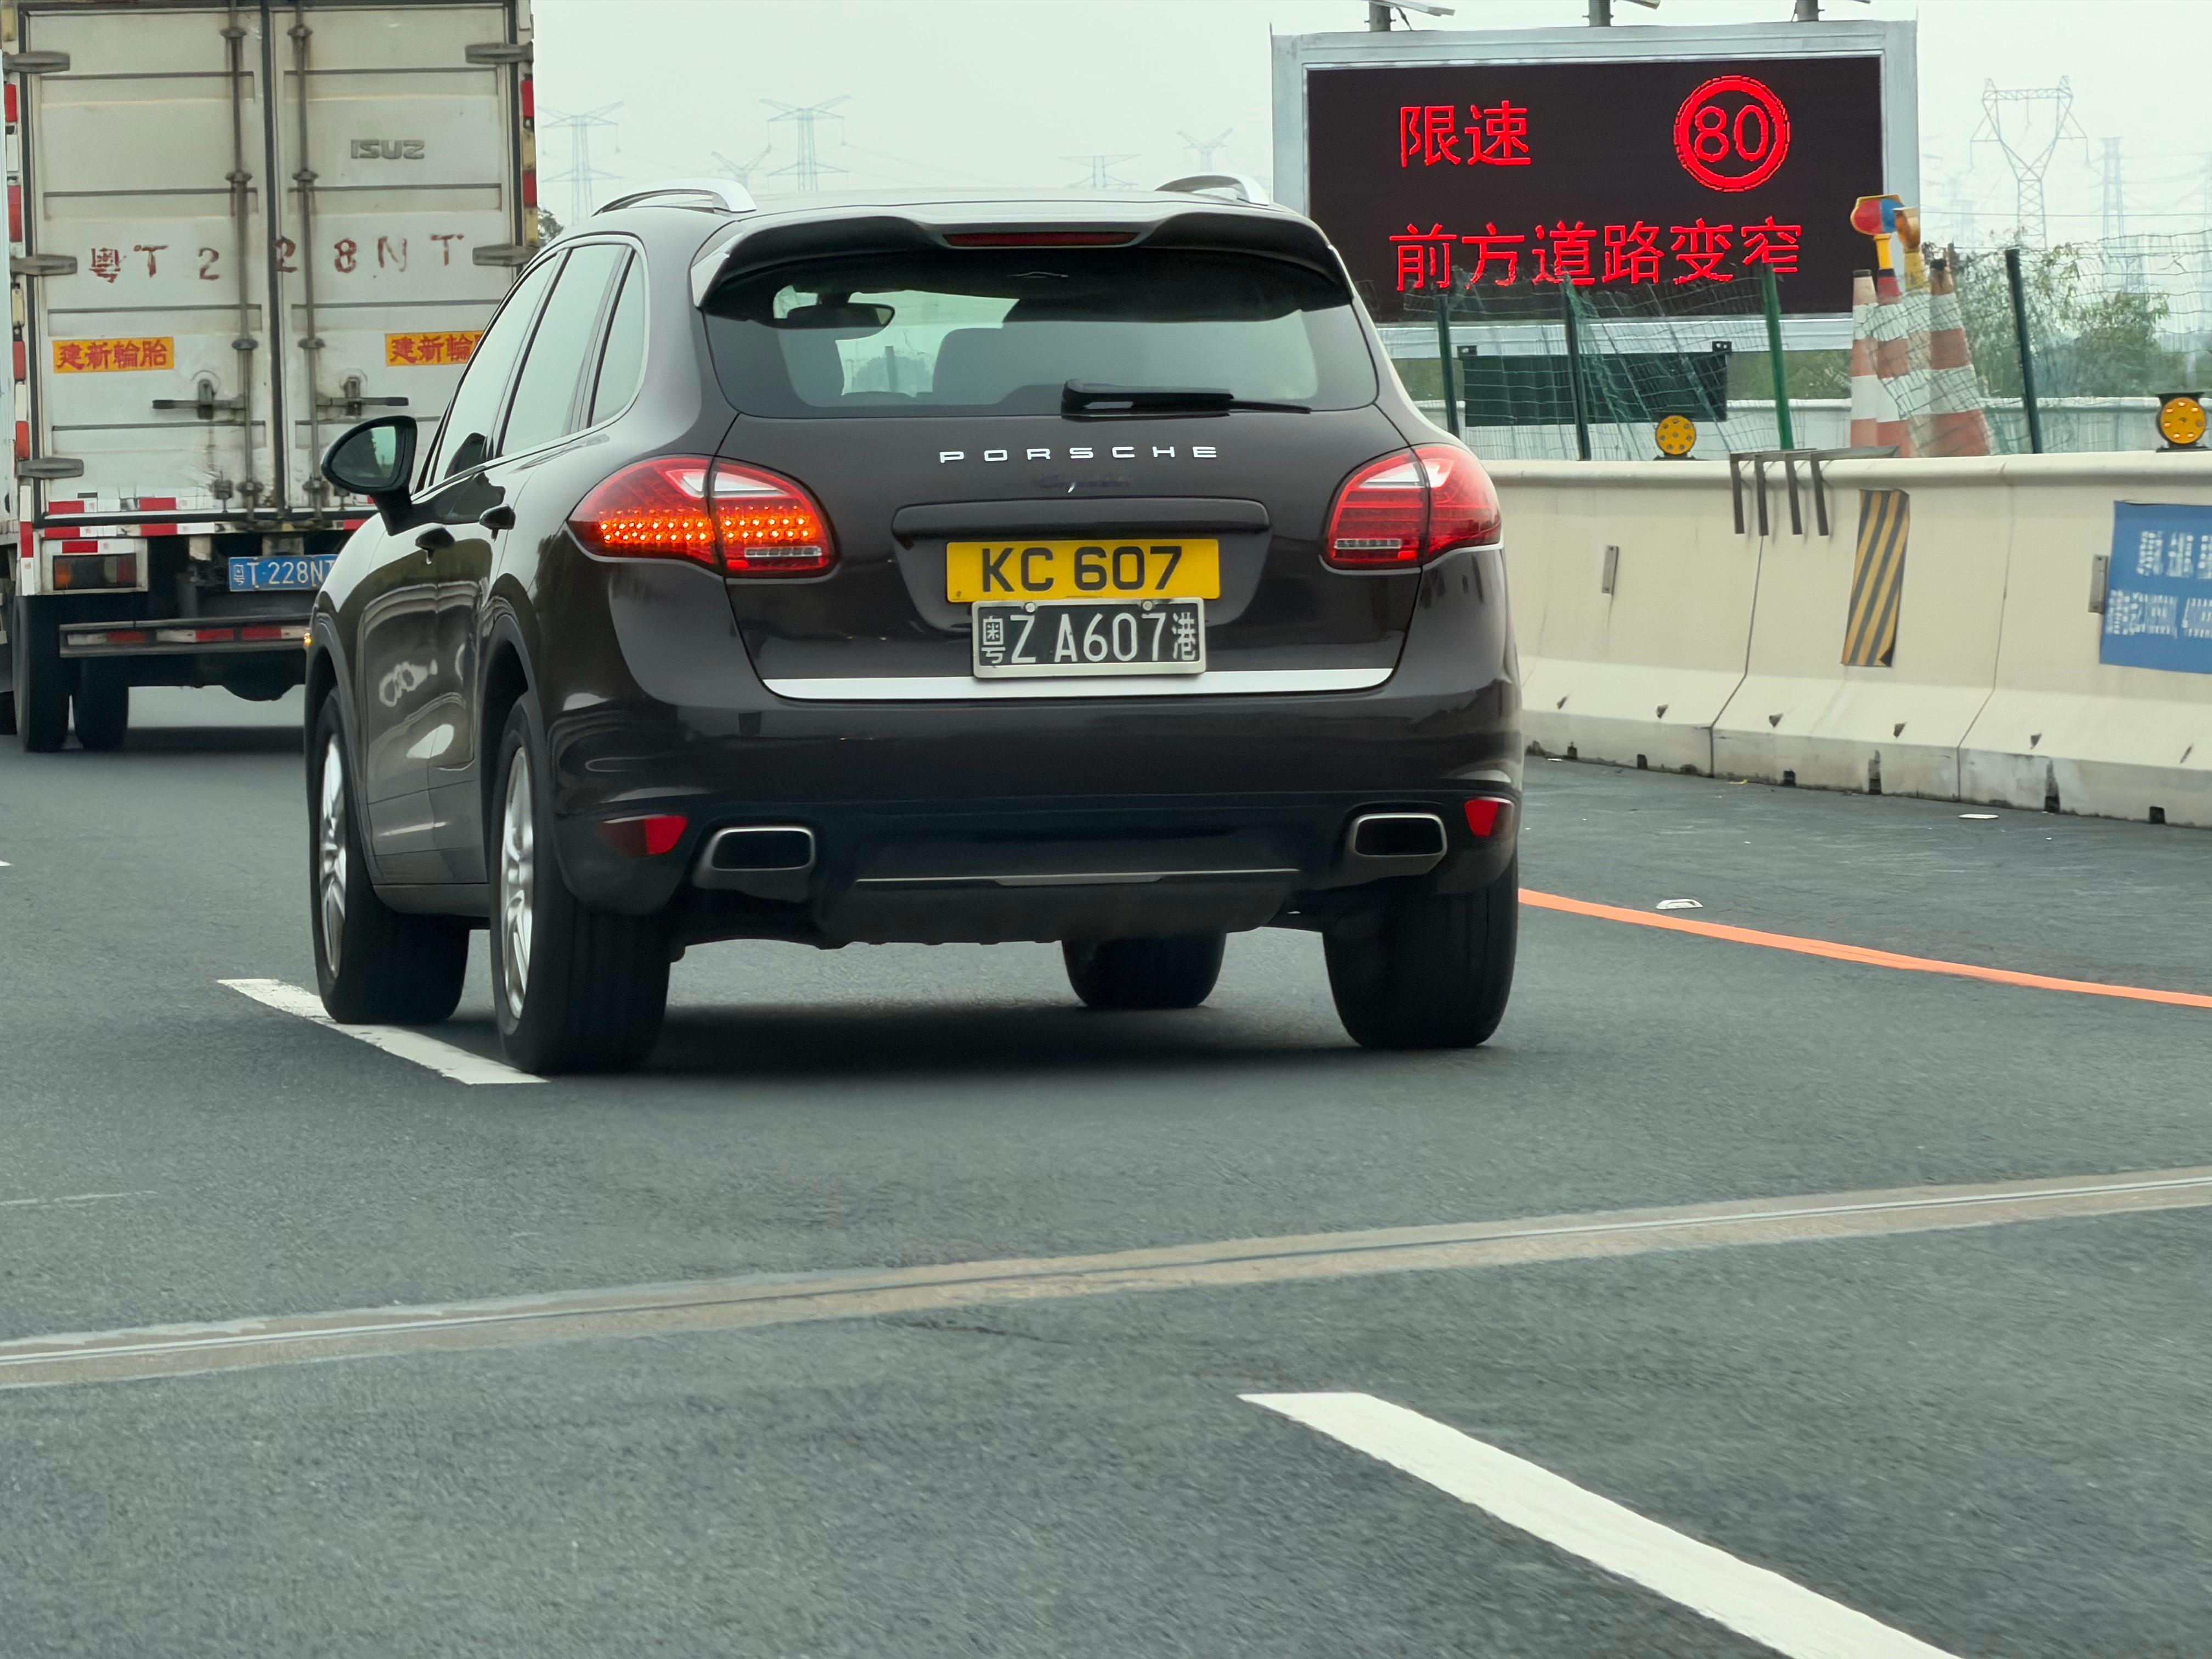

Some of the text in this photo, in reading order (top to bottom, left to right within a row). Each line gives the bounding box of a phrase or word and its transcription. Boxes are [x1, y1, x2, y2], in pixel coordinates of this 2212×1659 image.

[351, 139, 425, 160] ISUZ
[1400, 100, 1769, 167] 限速 80
[1389, 217, 1801, 291] 前方道路变窄
[390, 334, 481, 364] 建新輪
[940, 446, 1217, 463] PORSCHE
[982, 546, 1182, 592] KC 607
